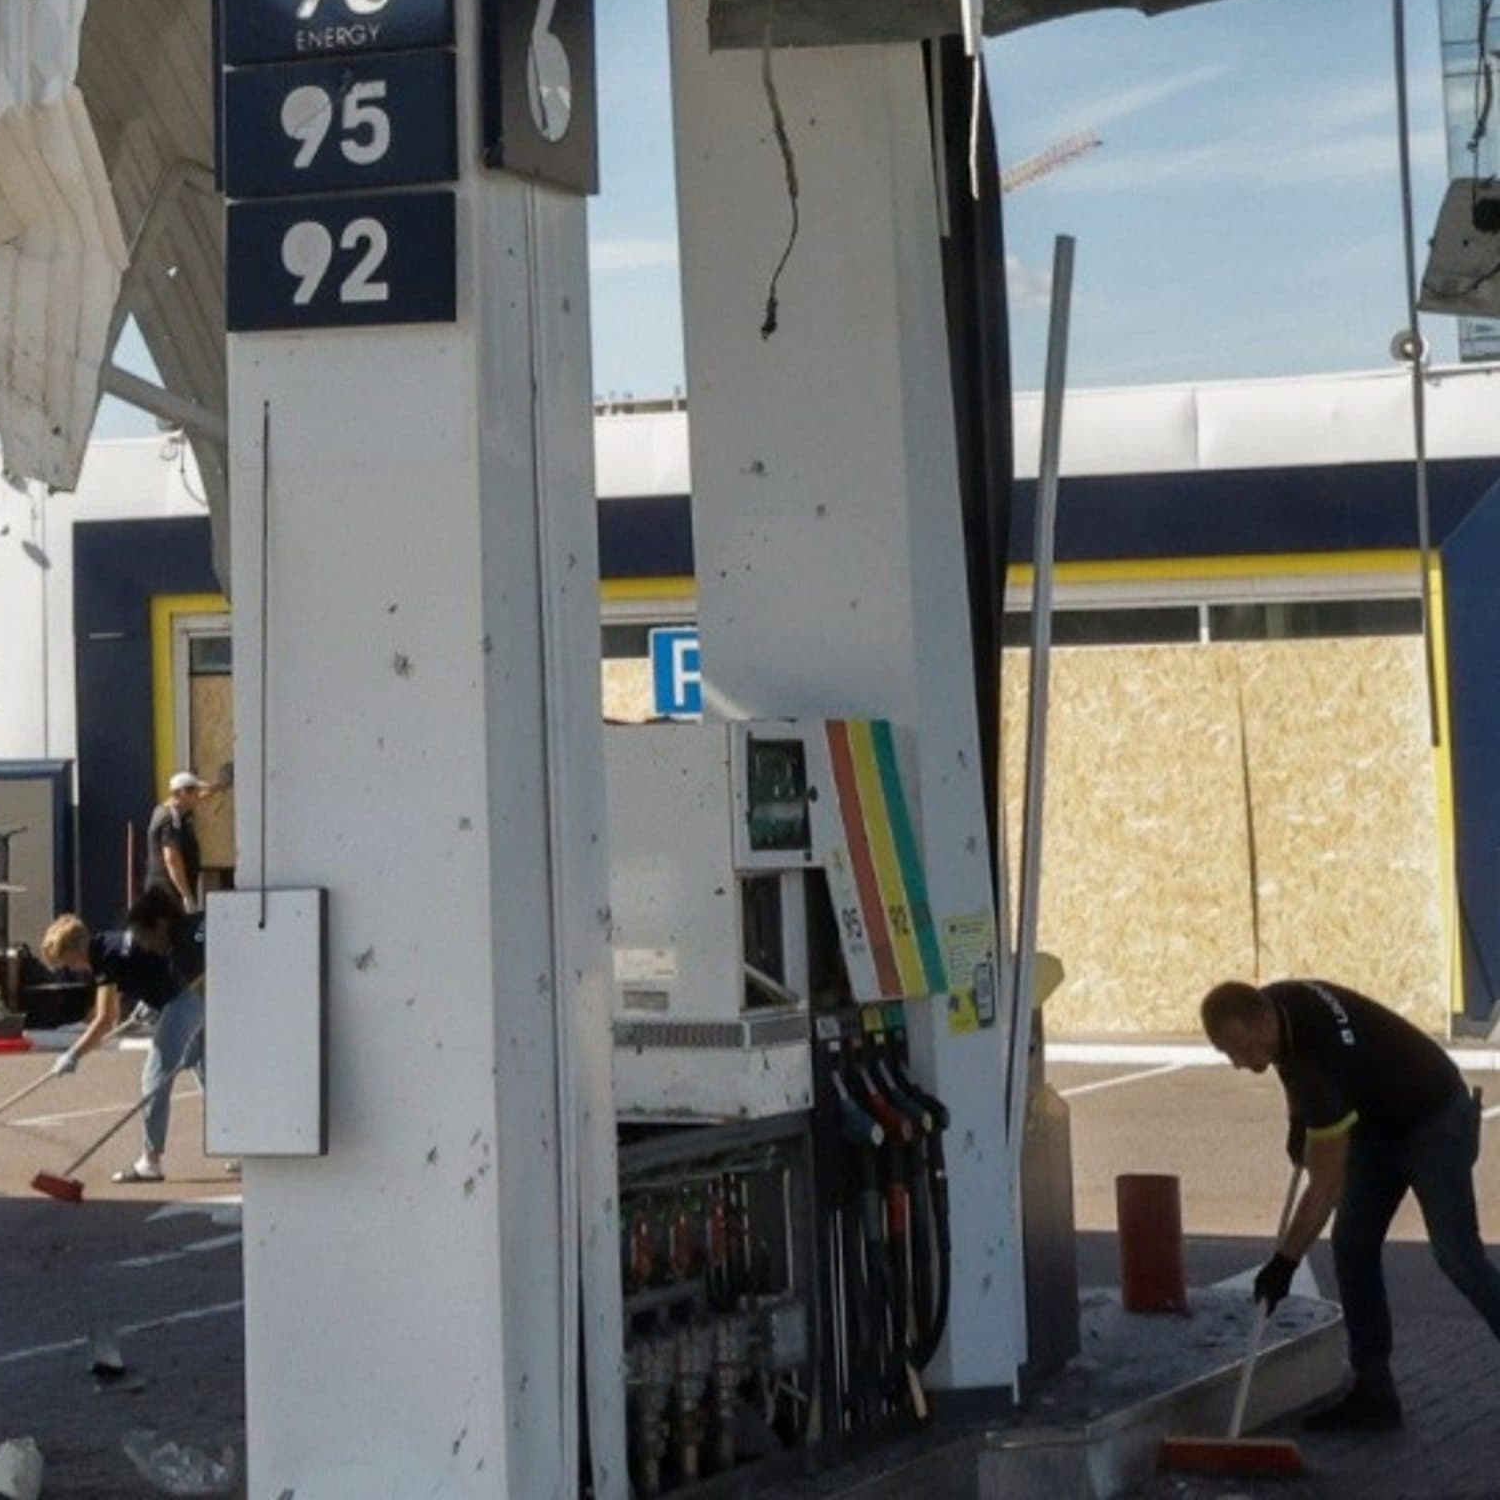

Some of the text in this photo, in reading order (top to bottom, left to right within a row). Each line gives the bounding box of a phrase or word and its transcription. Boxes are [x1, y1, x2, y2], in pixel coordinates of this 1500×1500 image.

[295, 23, 383, 50] ENERGY
[281, 81, 390, 169] 95
[281, 217, 388, 305] 92
